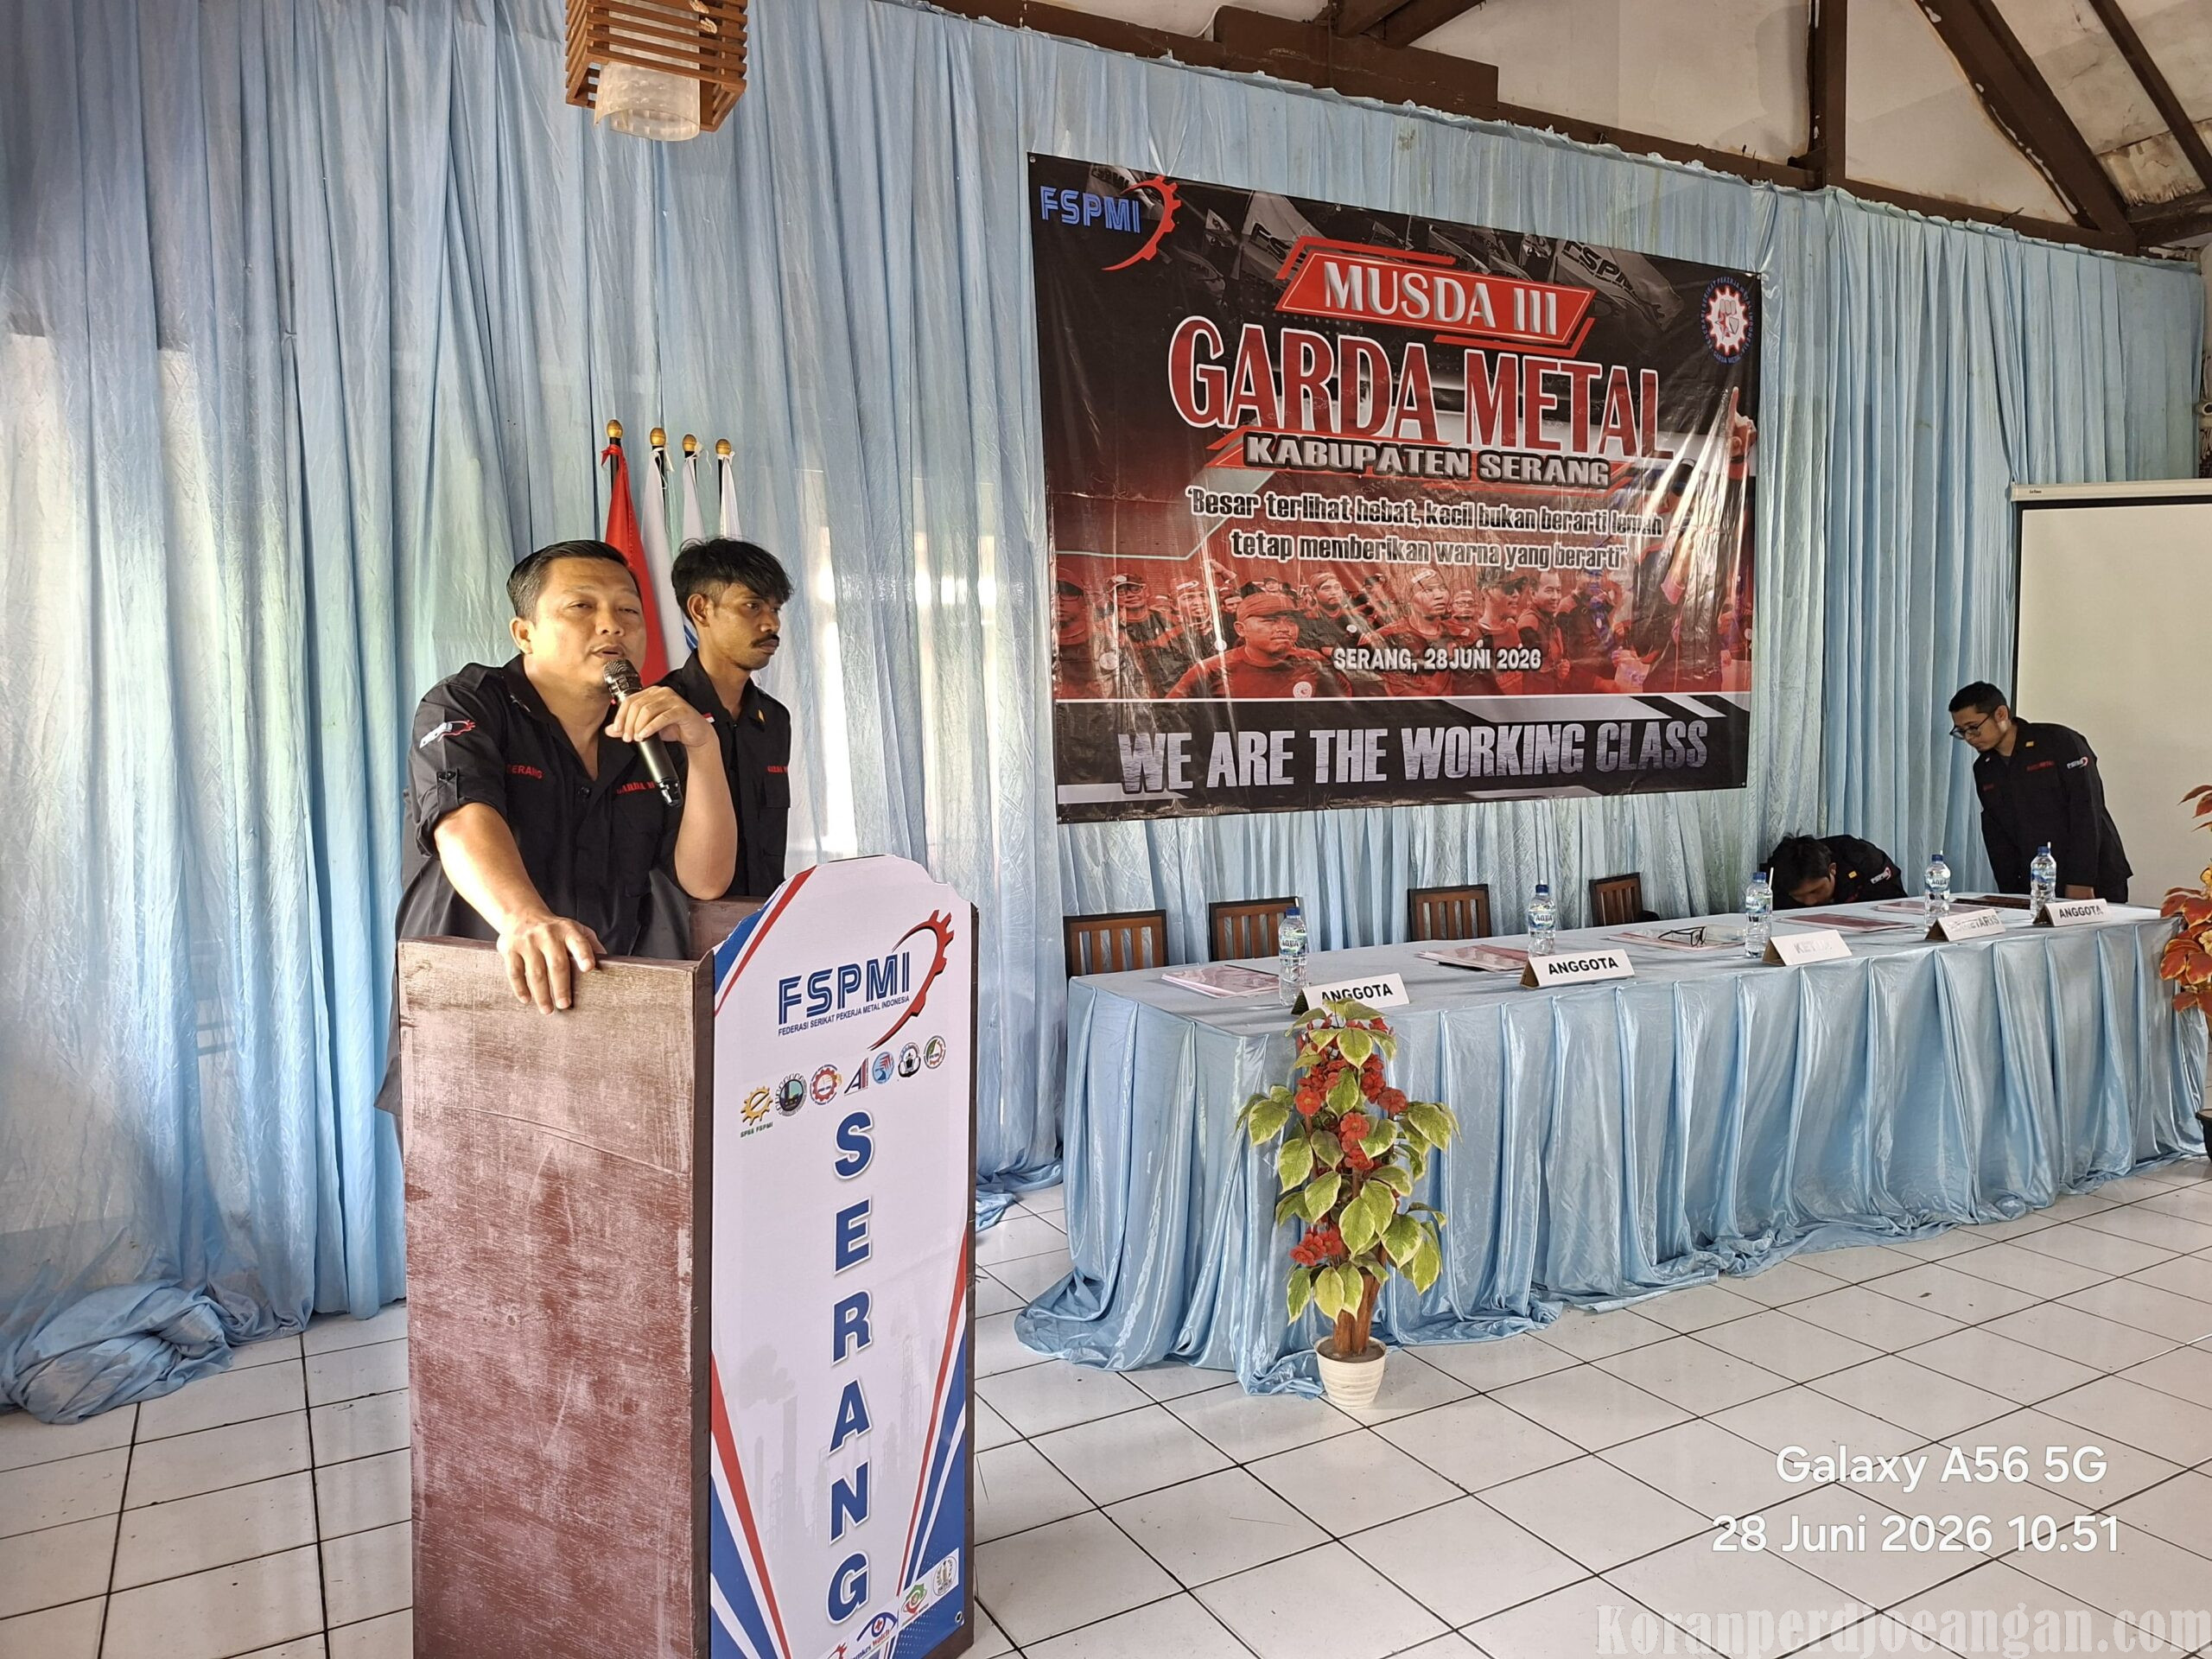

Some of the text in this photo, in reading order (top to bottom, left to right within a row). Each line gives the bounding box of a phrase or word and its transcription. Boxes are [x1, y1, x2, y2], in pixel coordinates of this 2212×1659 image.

[1039, 185, 1141, 233] FSPMI
[1324, 261, 1557, 335] MUSDA III
[1168, 315, 1675, 461] GARDA METAL
[1245, 435, 1610, 486] KABUPATEN SERANG
[1266, 493, 1351, 520] terlihat
[1355, 498, 1421, 527] hebat,
[1426, 502, 1473, 527] kecil
[1478, 504, 1536, 530] bukan
[1541, 506, 1607, 533] berarti
[1231, 531, 1294, 562] tetap
[1299, 536, 1429, 563] memberikan
[1435, 543, 1497, 565] warna
[1505, 544, 1550, 570] yang
[1333, 648, 1418, 673] SERANG,
[1497, 648, 1542, 671] 2026
[1117, 720, 1708, 791] WE ARE THE WORKING CLASS
[2059, 905, 2103, 919] ANGGOTA
[779, 951, 910, 1026] FSPMI
[1548, 957, 1619, 976] ANGGOTA
[1321, 983, 1394, 1001] ANGGOTA
[779, 995, 910, 1037] FEDERASI SERIKAT PEKERJA METAL INDONESIA
[827, 1109, 873, 1624] SERANG
